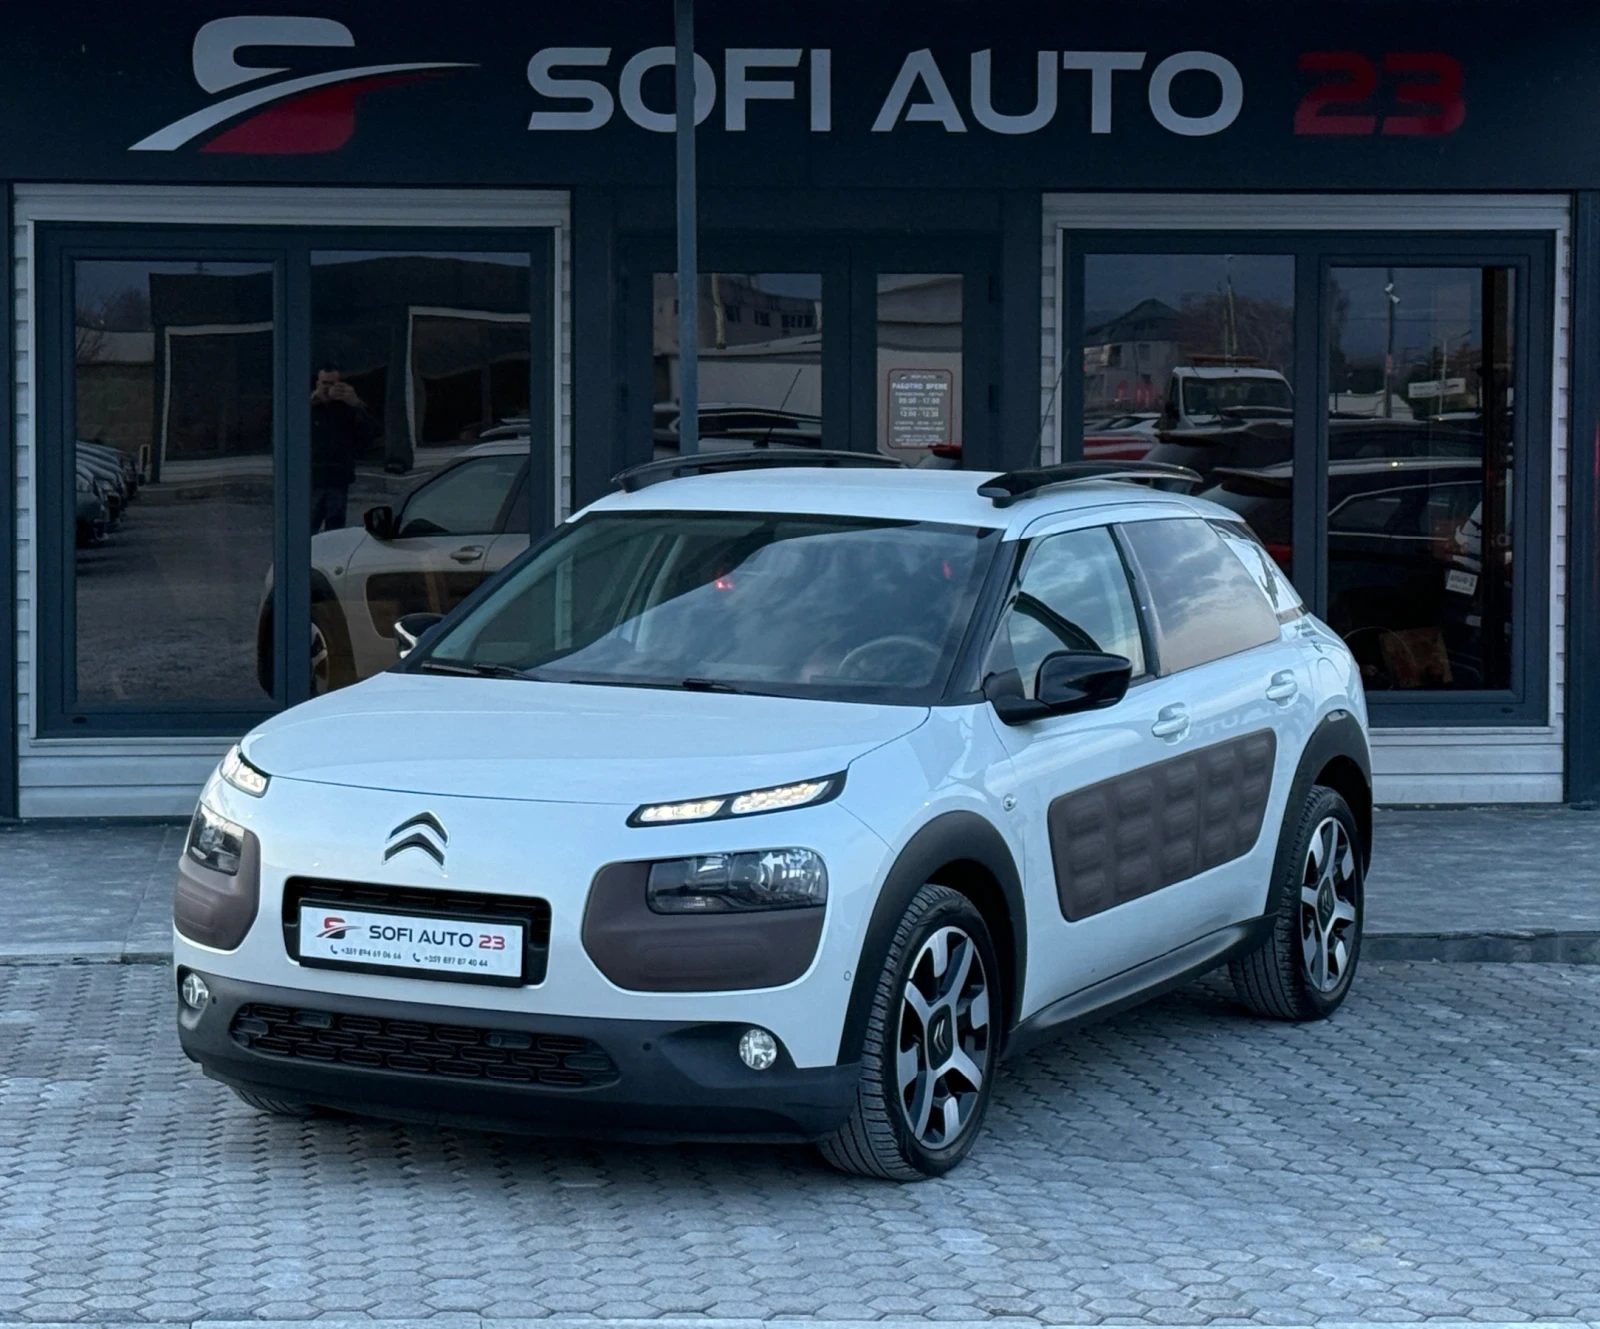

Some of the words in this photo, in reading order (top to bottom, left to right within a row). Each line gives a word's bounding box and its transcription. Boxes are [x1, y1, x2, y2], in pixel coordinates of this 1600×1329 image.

[527, 46, 831, 132] SOFI
[870, 48, 1244, 137] AUTO
[1294, 51, 1467, 136] 23
[369, 925, 413, 943] SOFI
[417, 930, 473, 948] AUTO
[478, 934, 505, 951] 23
[424, 955, 441, 963] +359
